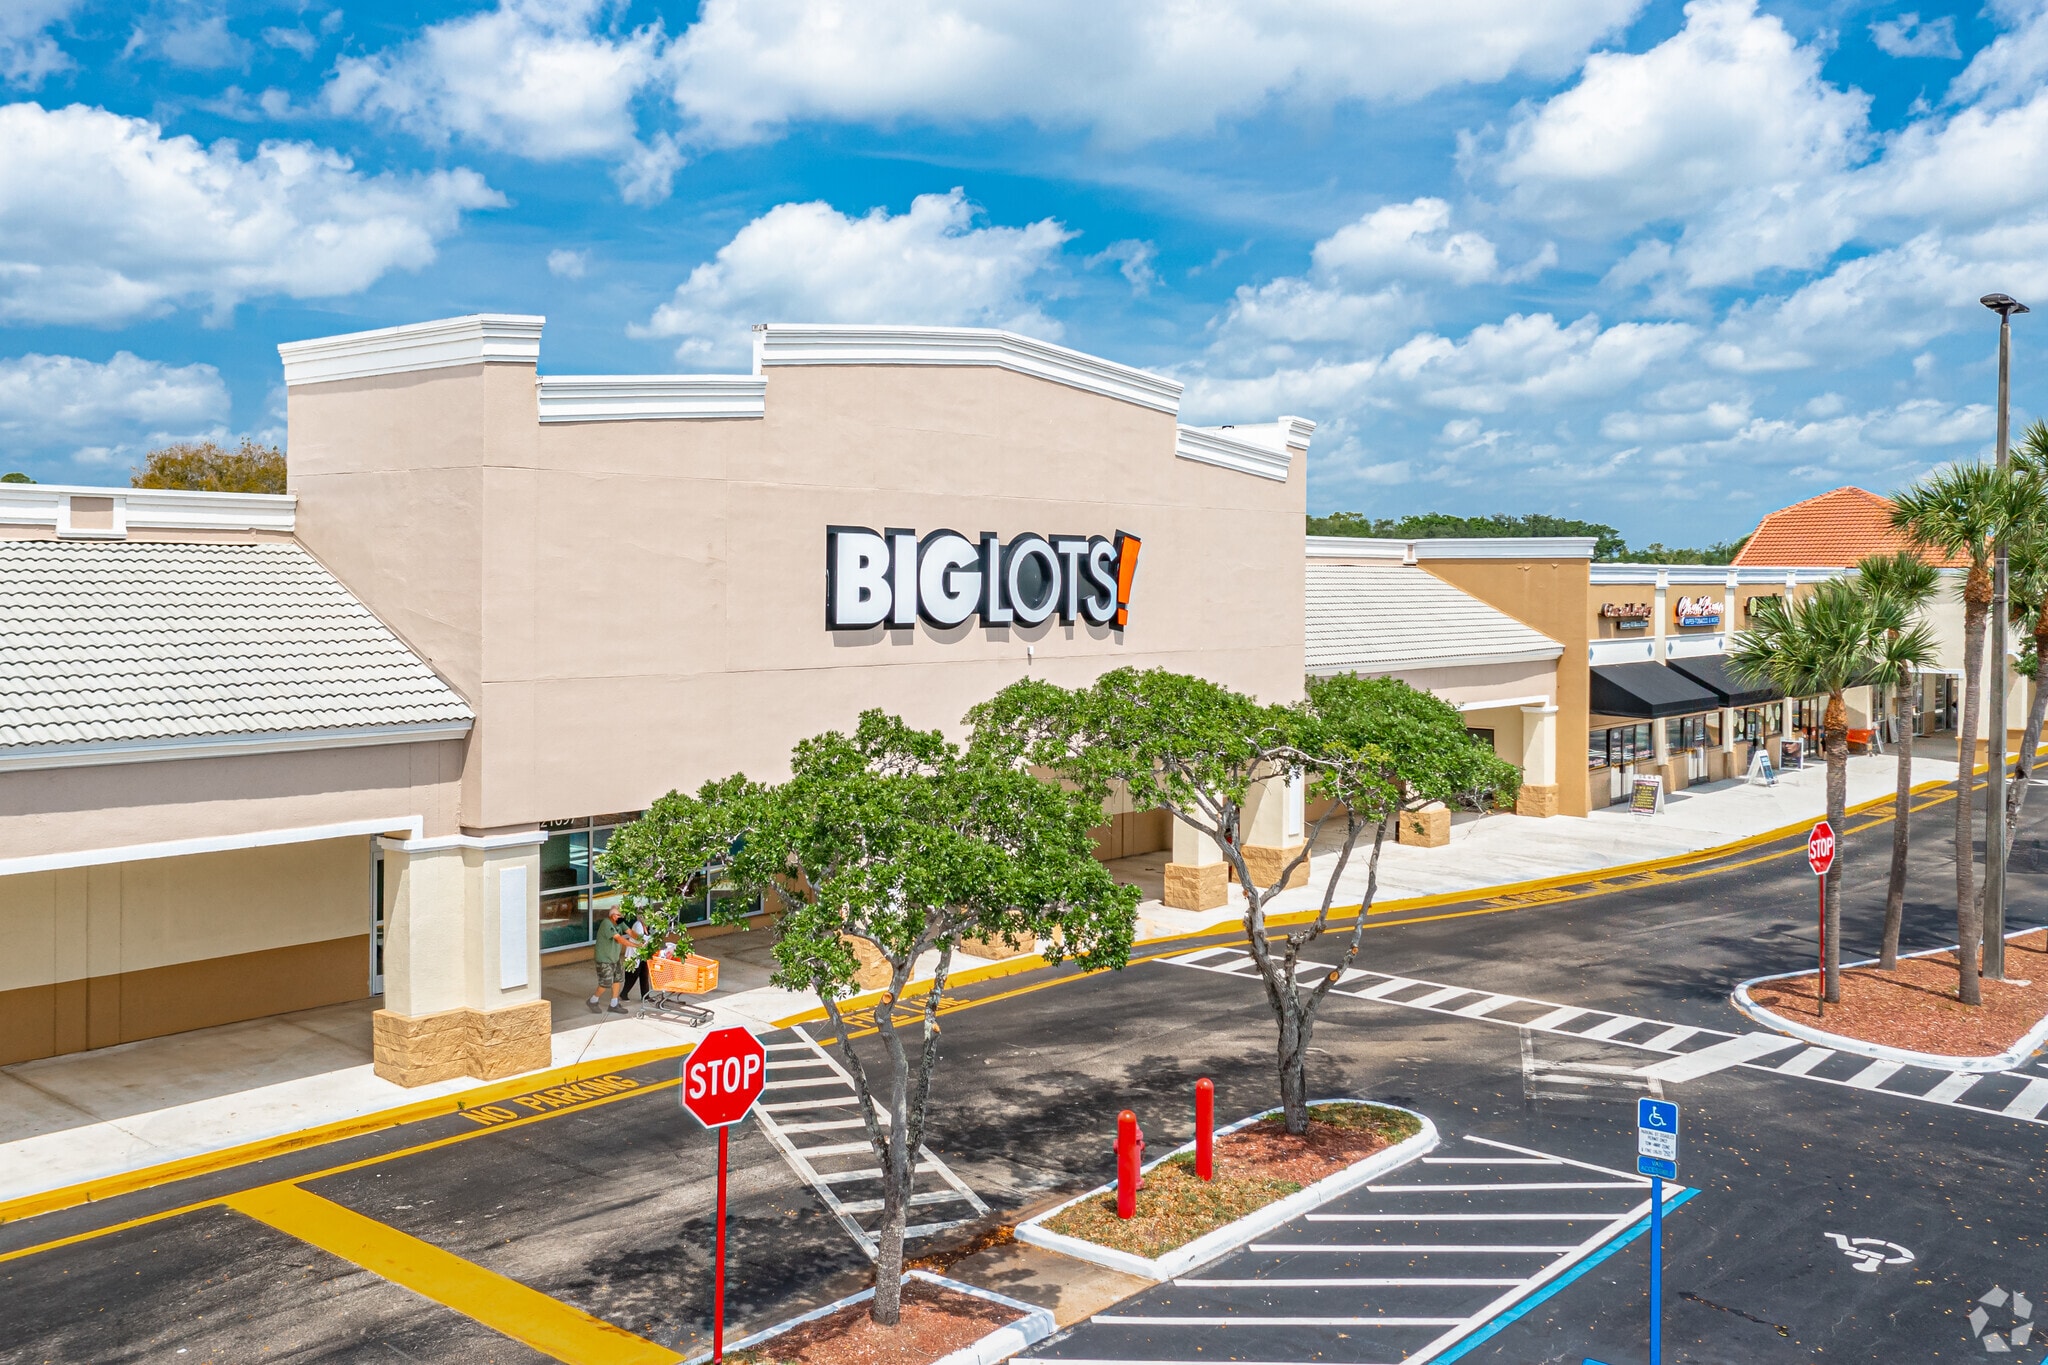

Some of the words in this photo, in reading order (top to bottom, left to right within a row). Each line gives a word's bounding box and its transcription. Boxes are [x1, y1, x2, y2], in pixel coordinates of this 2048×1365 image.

[831, 529, 982, 628] BIG
[985, 533, 1142, 627] LOTS!
[1810, 836, 1833, 859] STOP
[688, 1053, 761, 1100] STOP
[458, 1105, 518, 1126] NO
[512, 1075, 640, 1112] PARKING
[1651, 1160, 1664, 1168] VAN
